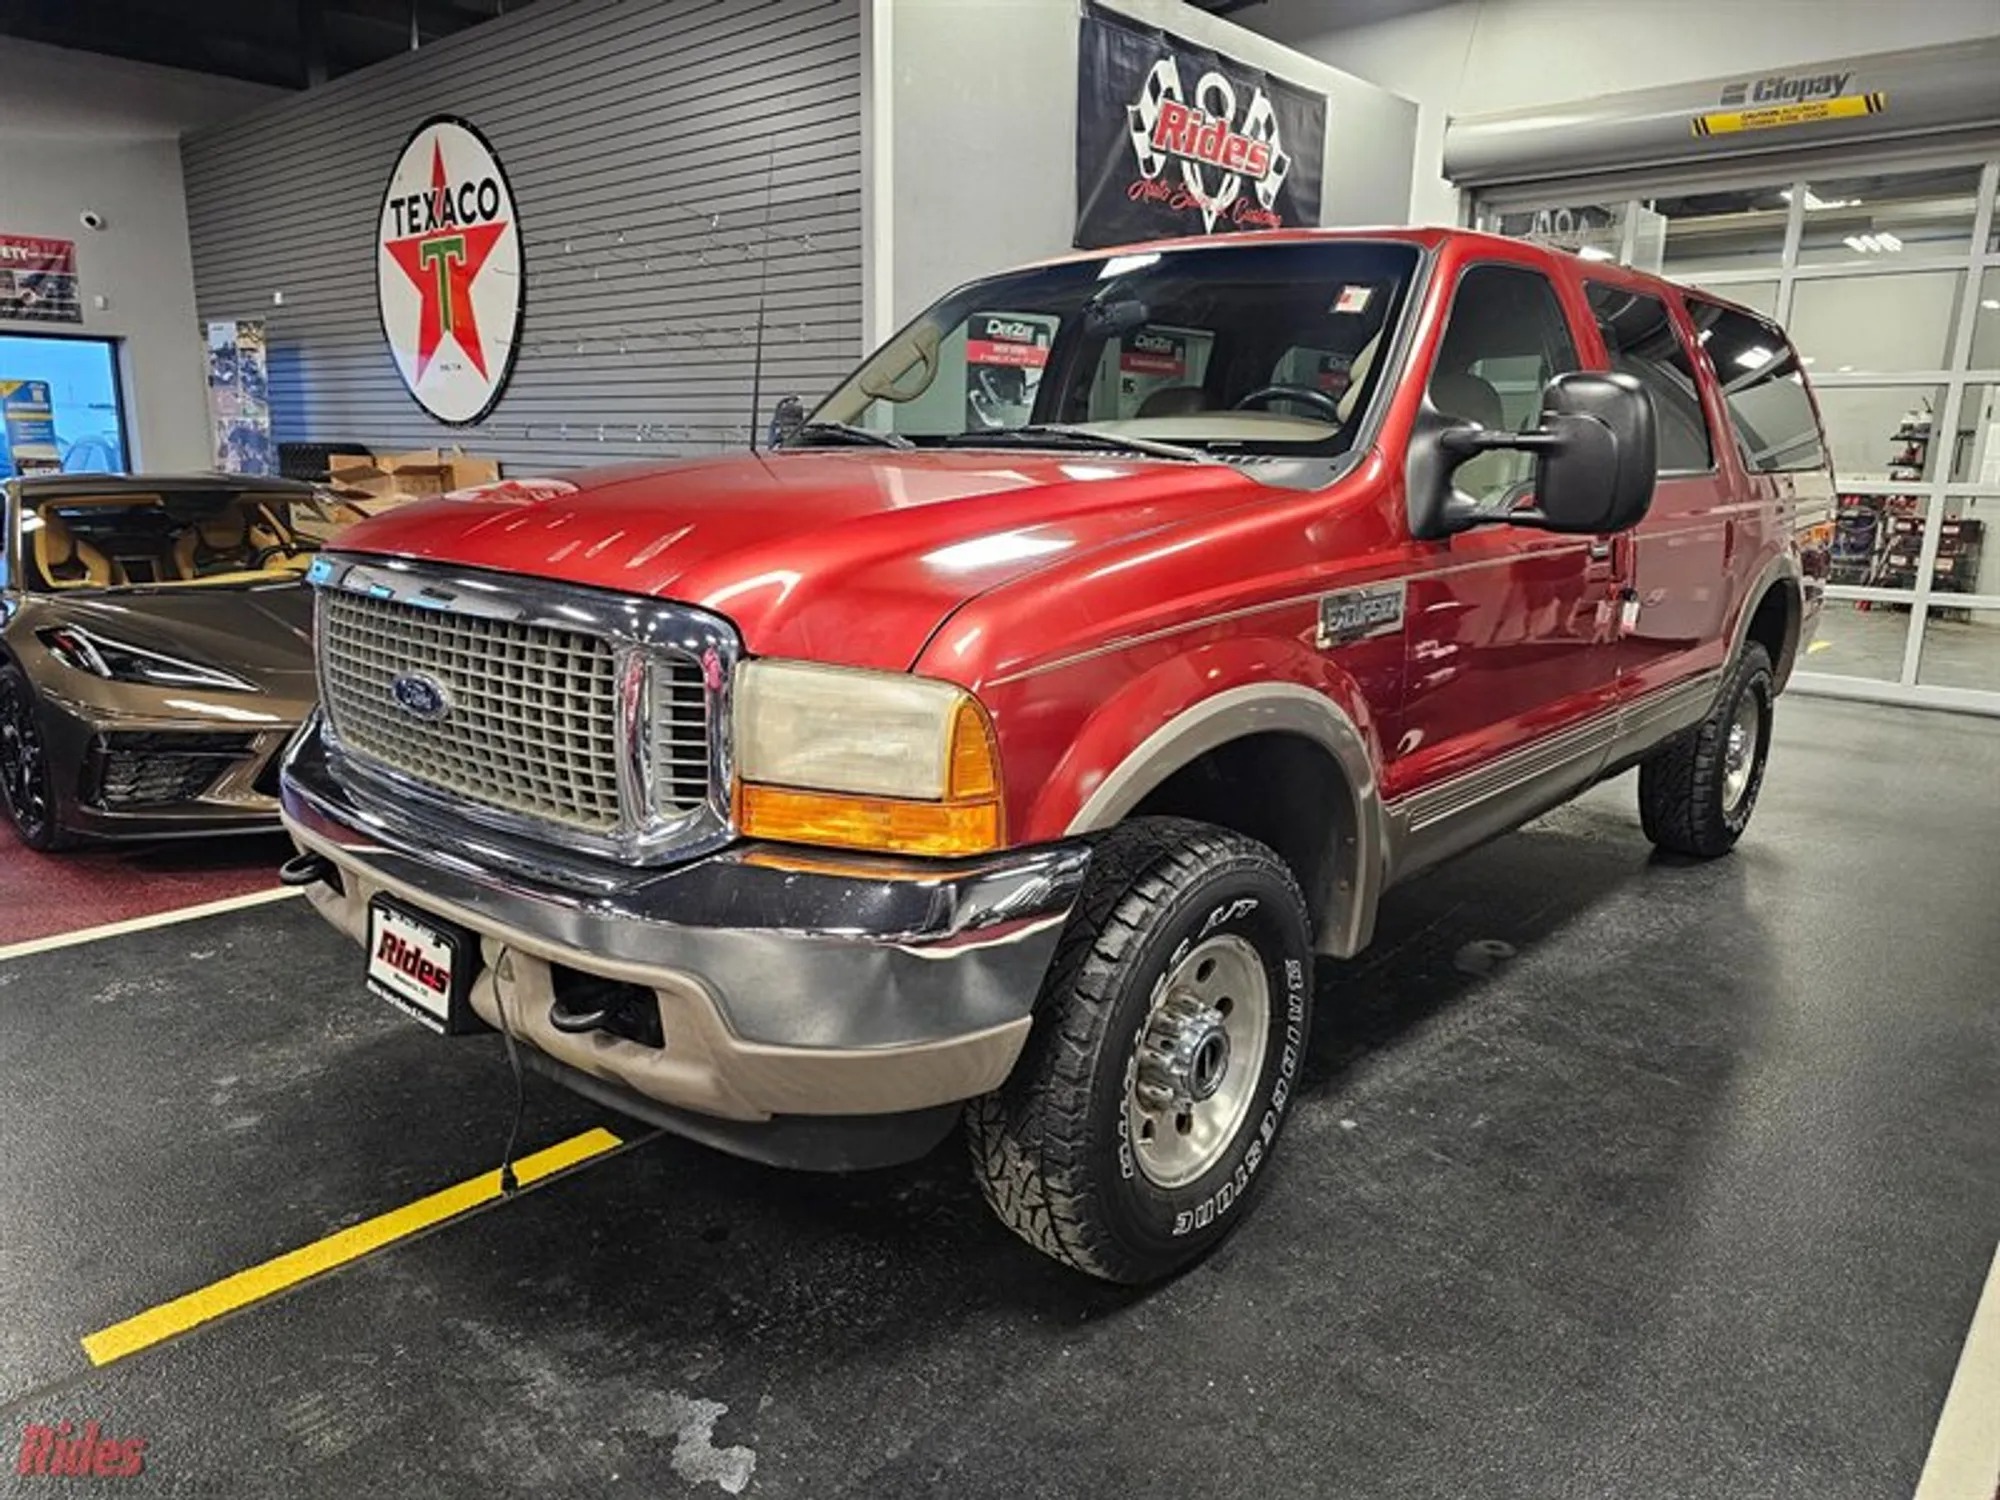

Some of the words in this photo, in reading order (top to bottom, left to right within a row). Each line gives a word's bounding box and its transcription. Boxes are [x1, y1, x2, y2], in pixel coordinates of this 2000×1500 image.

[1152, 98, 1271, 180] Rides
[390, 176, 499, 238] TEXACO
[420, 235, 466, 332] T
[376, 929, 452, 995] Rides
